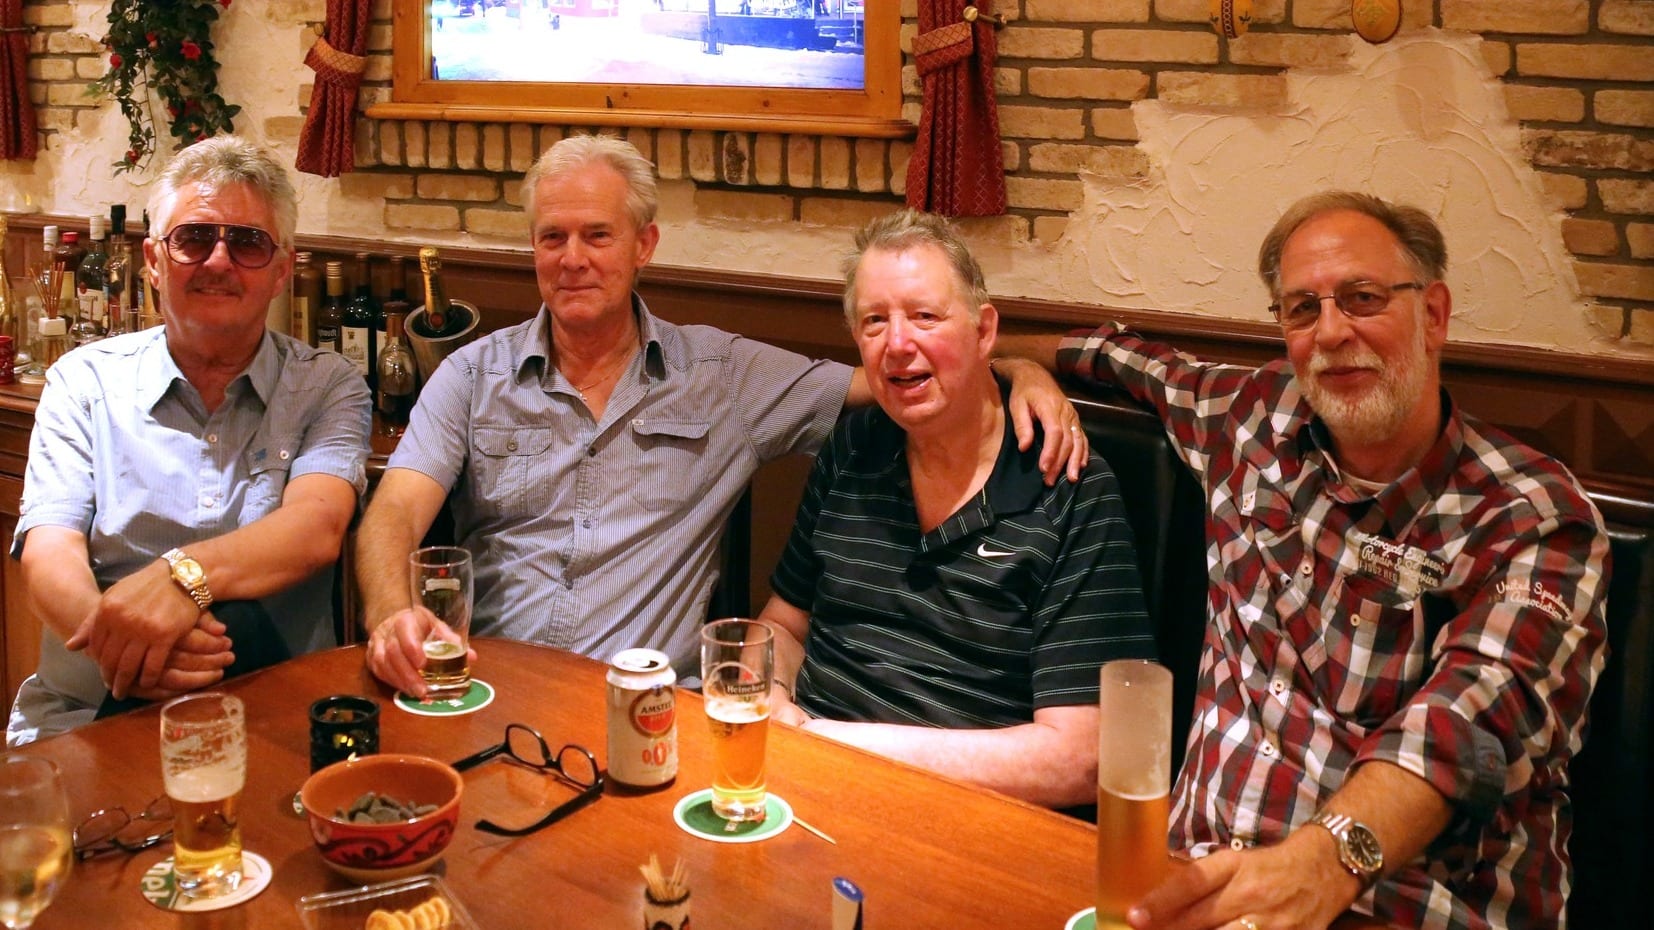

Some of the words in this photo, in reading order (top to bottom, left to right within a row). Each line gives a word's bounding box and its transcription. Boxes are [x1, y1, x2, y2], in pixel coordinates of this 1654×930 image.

[1496, 581, 1530, 594] United
[1510, 591, 1562, 620] Association
[727, 683, 766, 693] Heineken
[641, 702, 672, 714] AMSTEL
